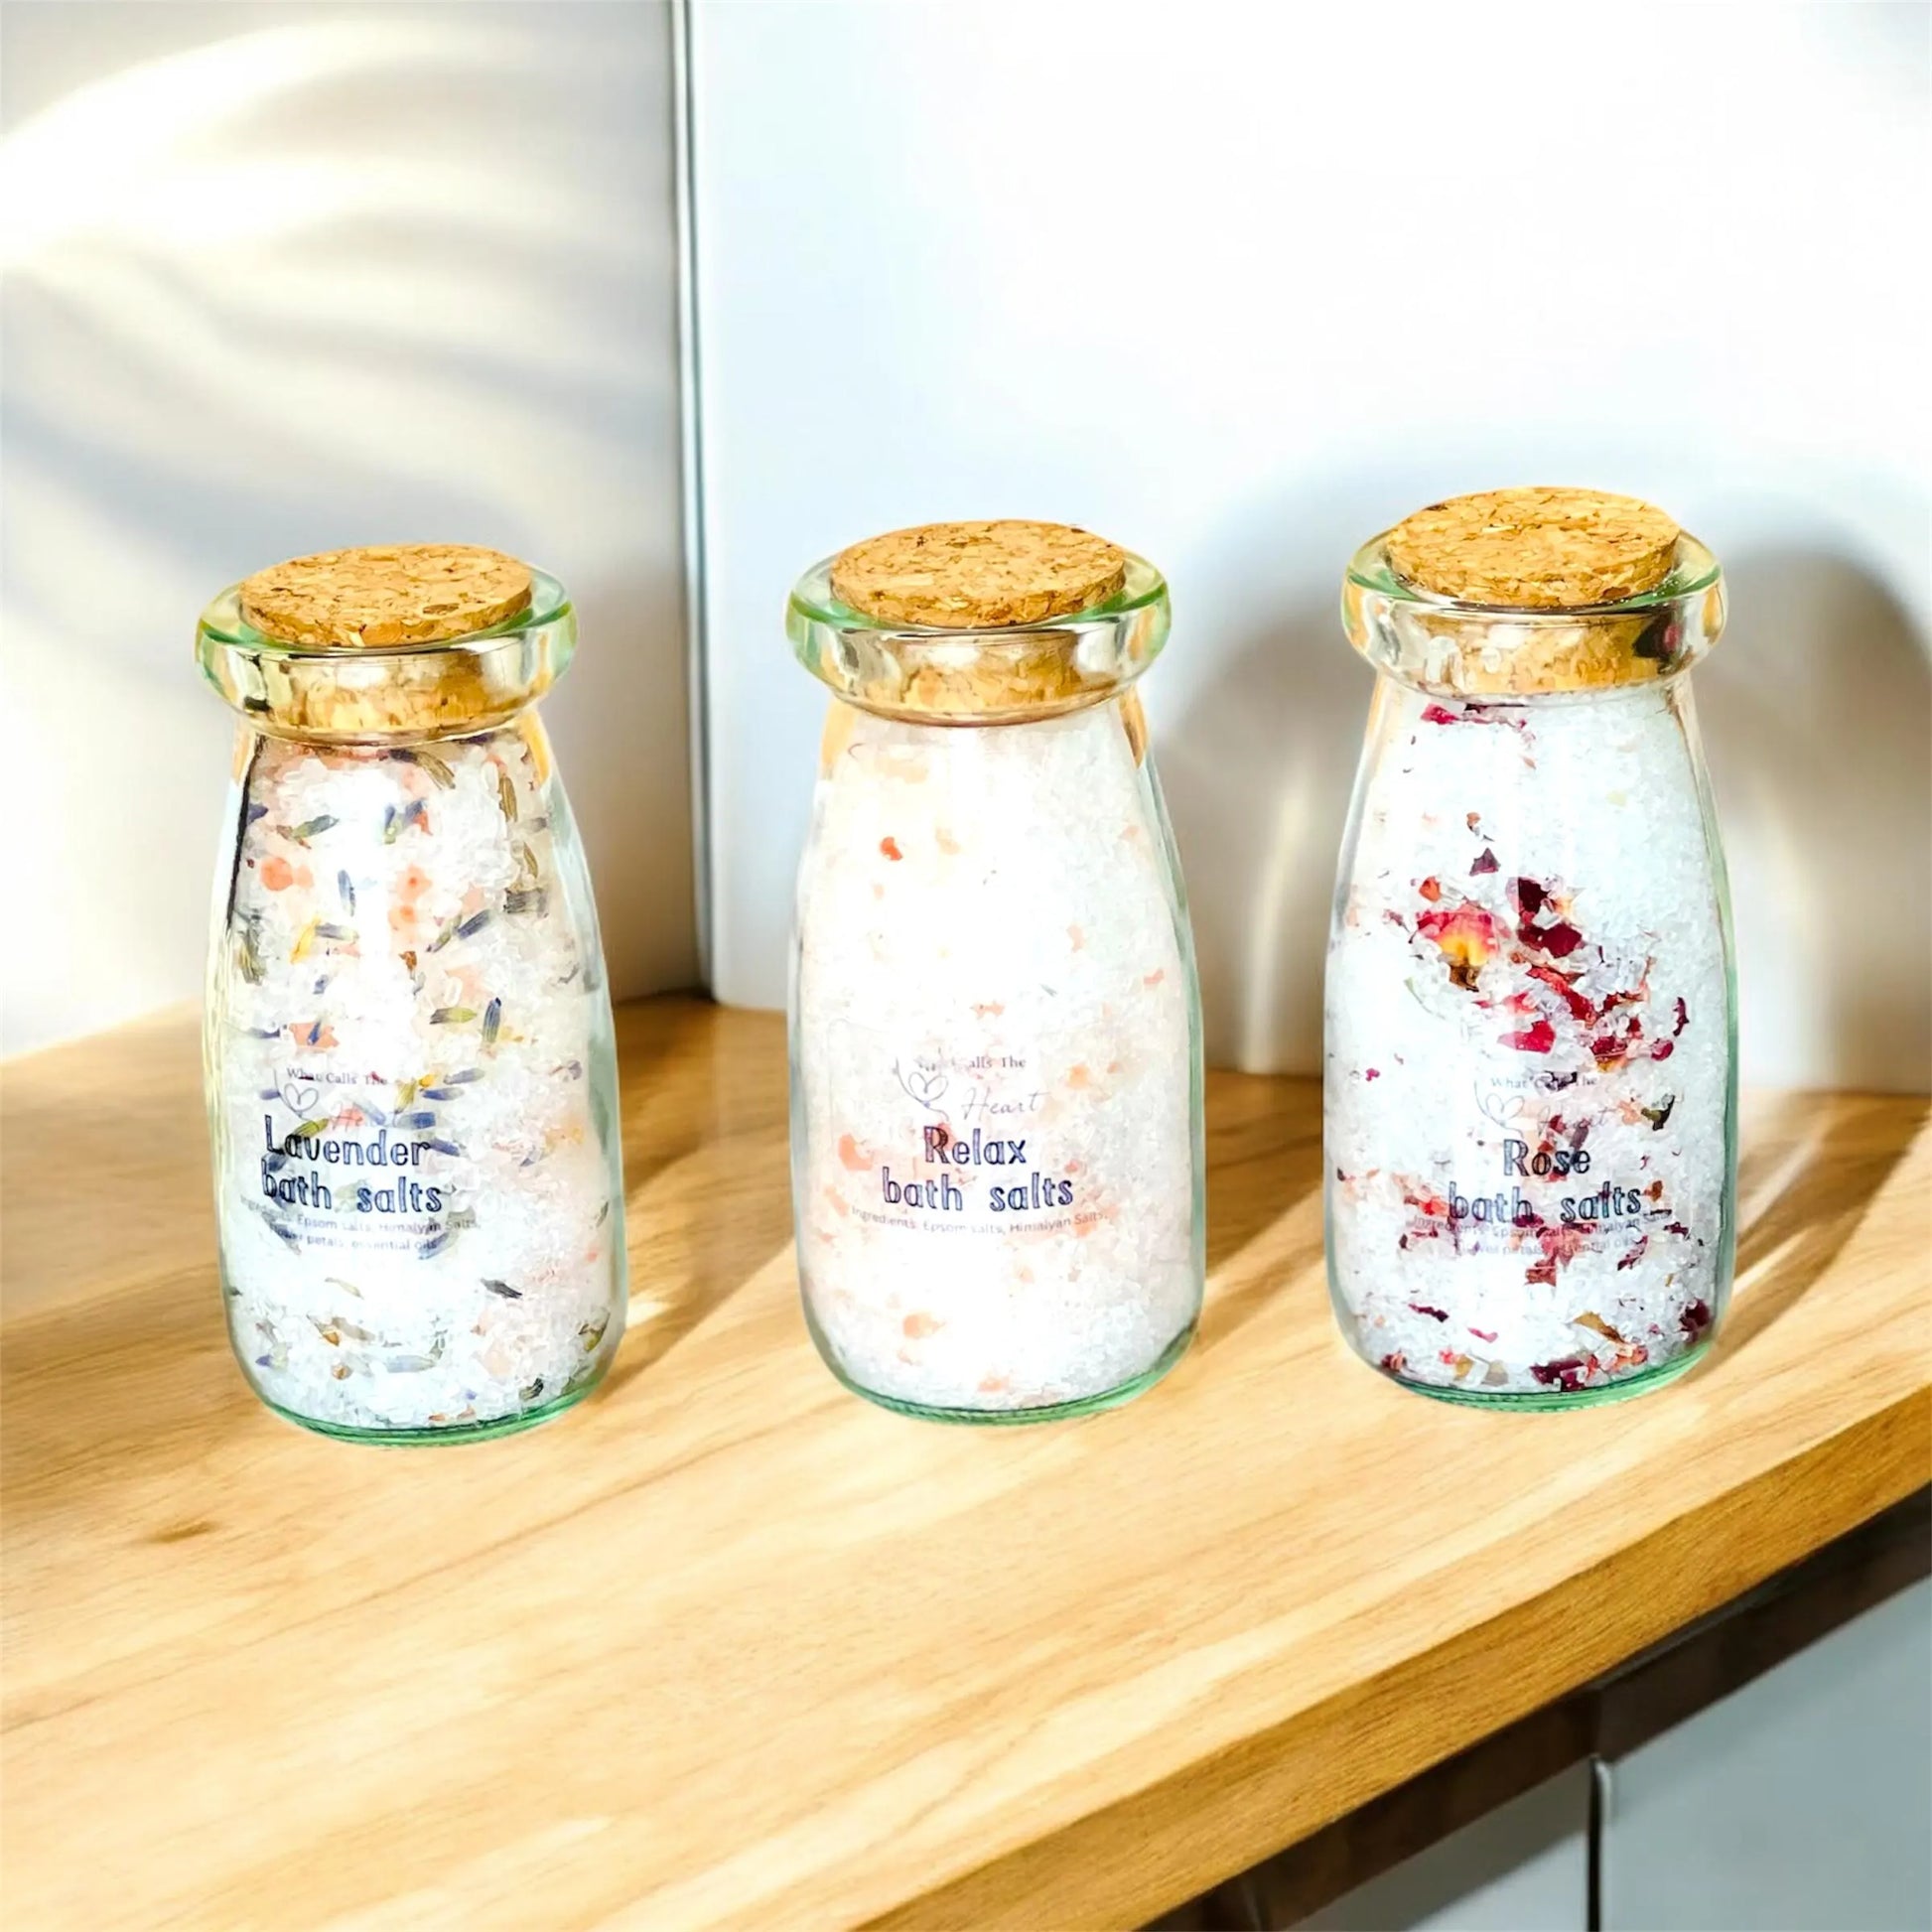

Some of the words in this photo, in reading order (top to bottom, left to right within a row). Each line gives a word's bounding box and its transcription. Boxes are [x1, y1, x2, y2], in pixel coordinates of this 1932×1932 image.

[326, 1072, 357, 1084] Calls
[960, 1085, 1052, 1122] Heart
[264, 1114, 431, 1167] Lavender
[923, 1126, 1028, 1166] Relax
[1503, 1139, 1591, 1176] Rose
[261, 1159, 333, 1210] bath
[356, 1176, 443, 1213] salts
[883, 1167, 963, 1211] bath
[989, 1173, 1074, 1212] salts
[1449, 1180, 1534, 1223] bath
[1560, 1180, 1642, 1223] salts
